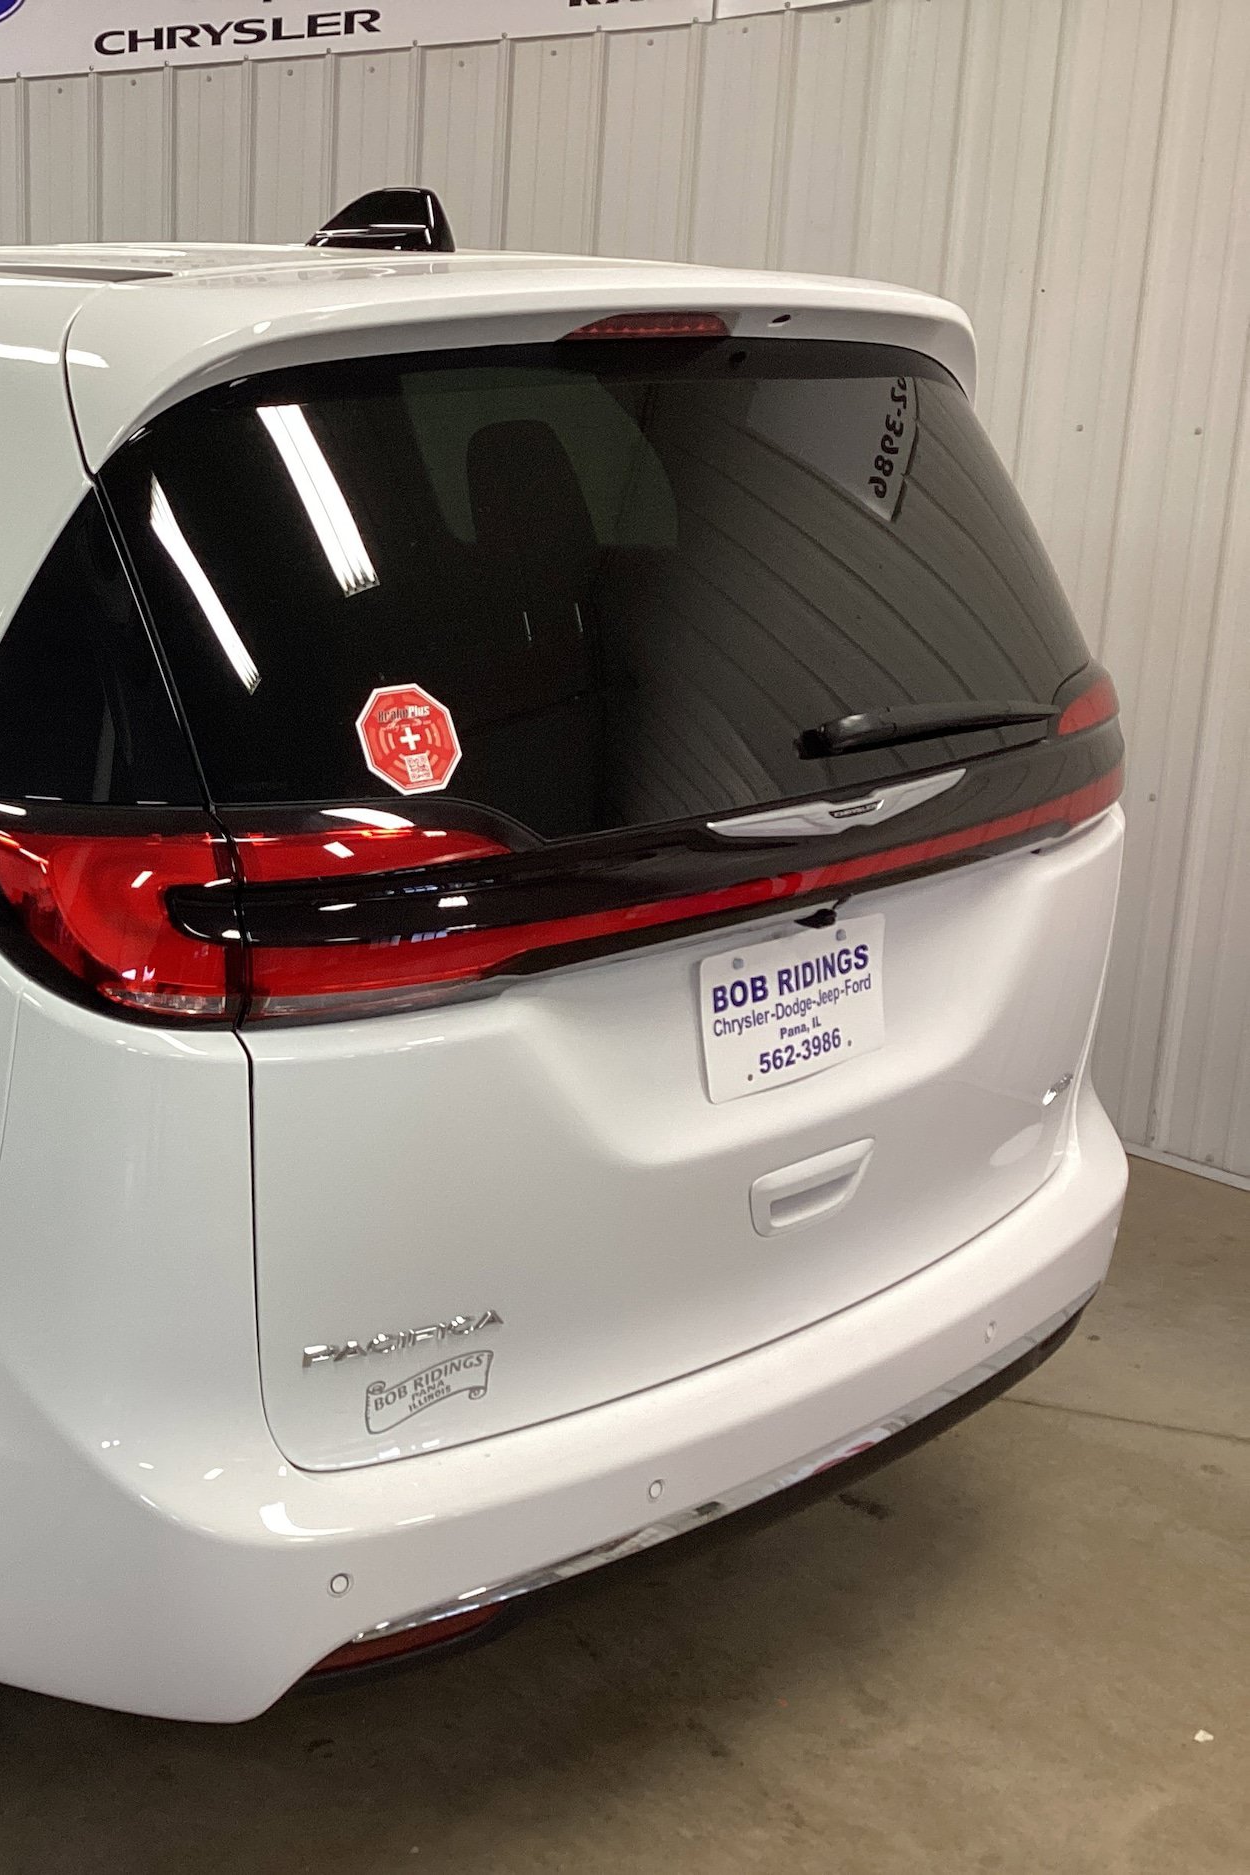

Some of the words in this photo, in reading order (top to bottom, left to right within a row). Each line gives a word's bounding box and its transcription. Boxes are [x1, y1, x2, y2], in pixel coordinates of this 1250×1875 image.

[94, 9, 382, 56] CHRYSLER
[712, 975, 769, 1014] BOB
[777, 944, 869, 996] RIDINGS
[713, 973, 872, 1037] Chrysler-Dodge-Jeep-Ford
[779, 1022, 810, 1039] Pana,
[812, 1016, 822, 1028] IL
[759, 1028, 842, 1074] 562-3986
[302, 1309, 504, 1368] PACIFICA
[373, 1384, 408, 1411] BOB
[413, 1353, 485, 1391] RIDINGS
[408, 1386, 452, 1412] ILLINOIS
[411, 1380, 445, 1401] PANA
